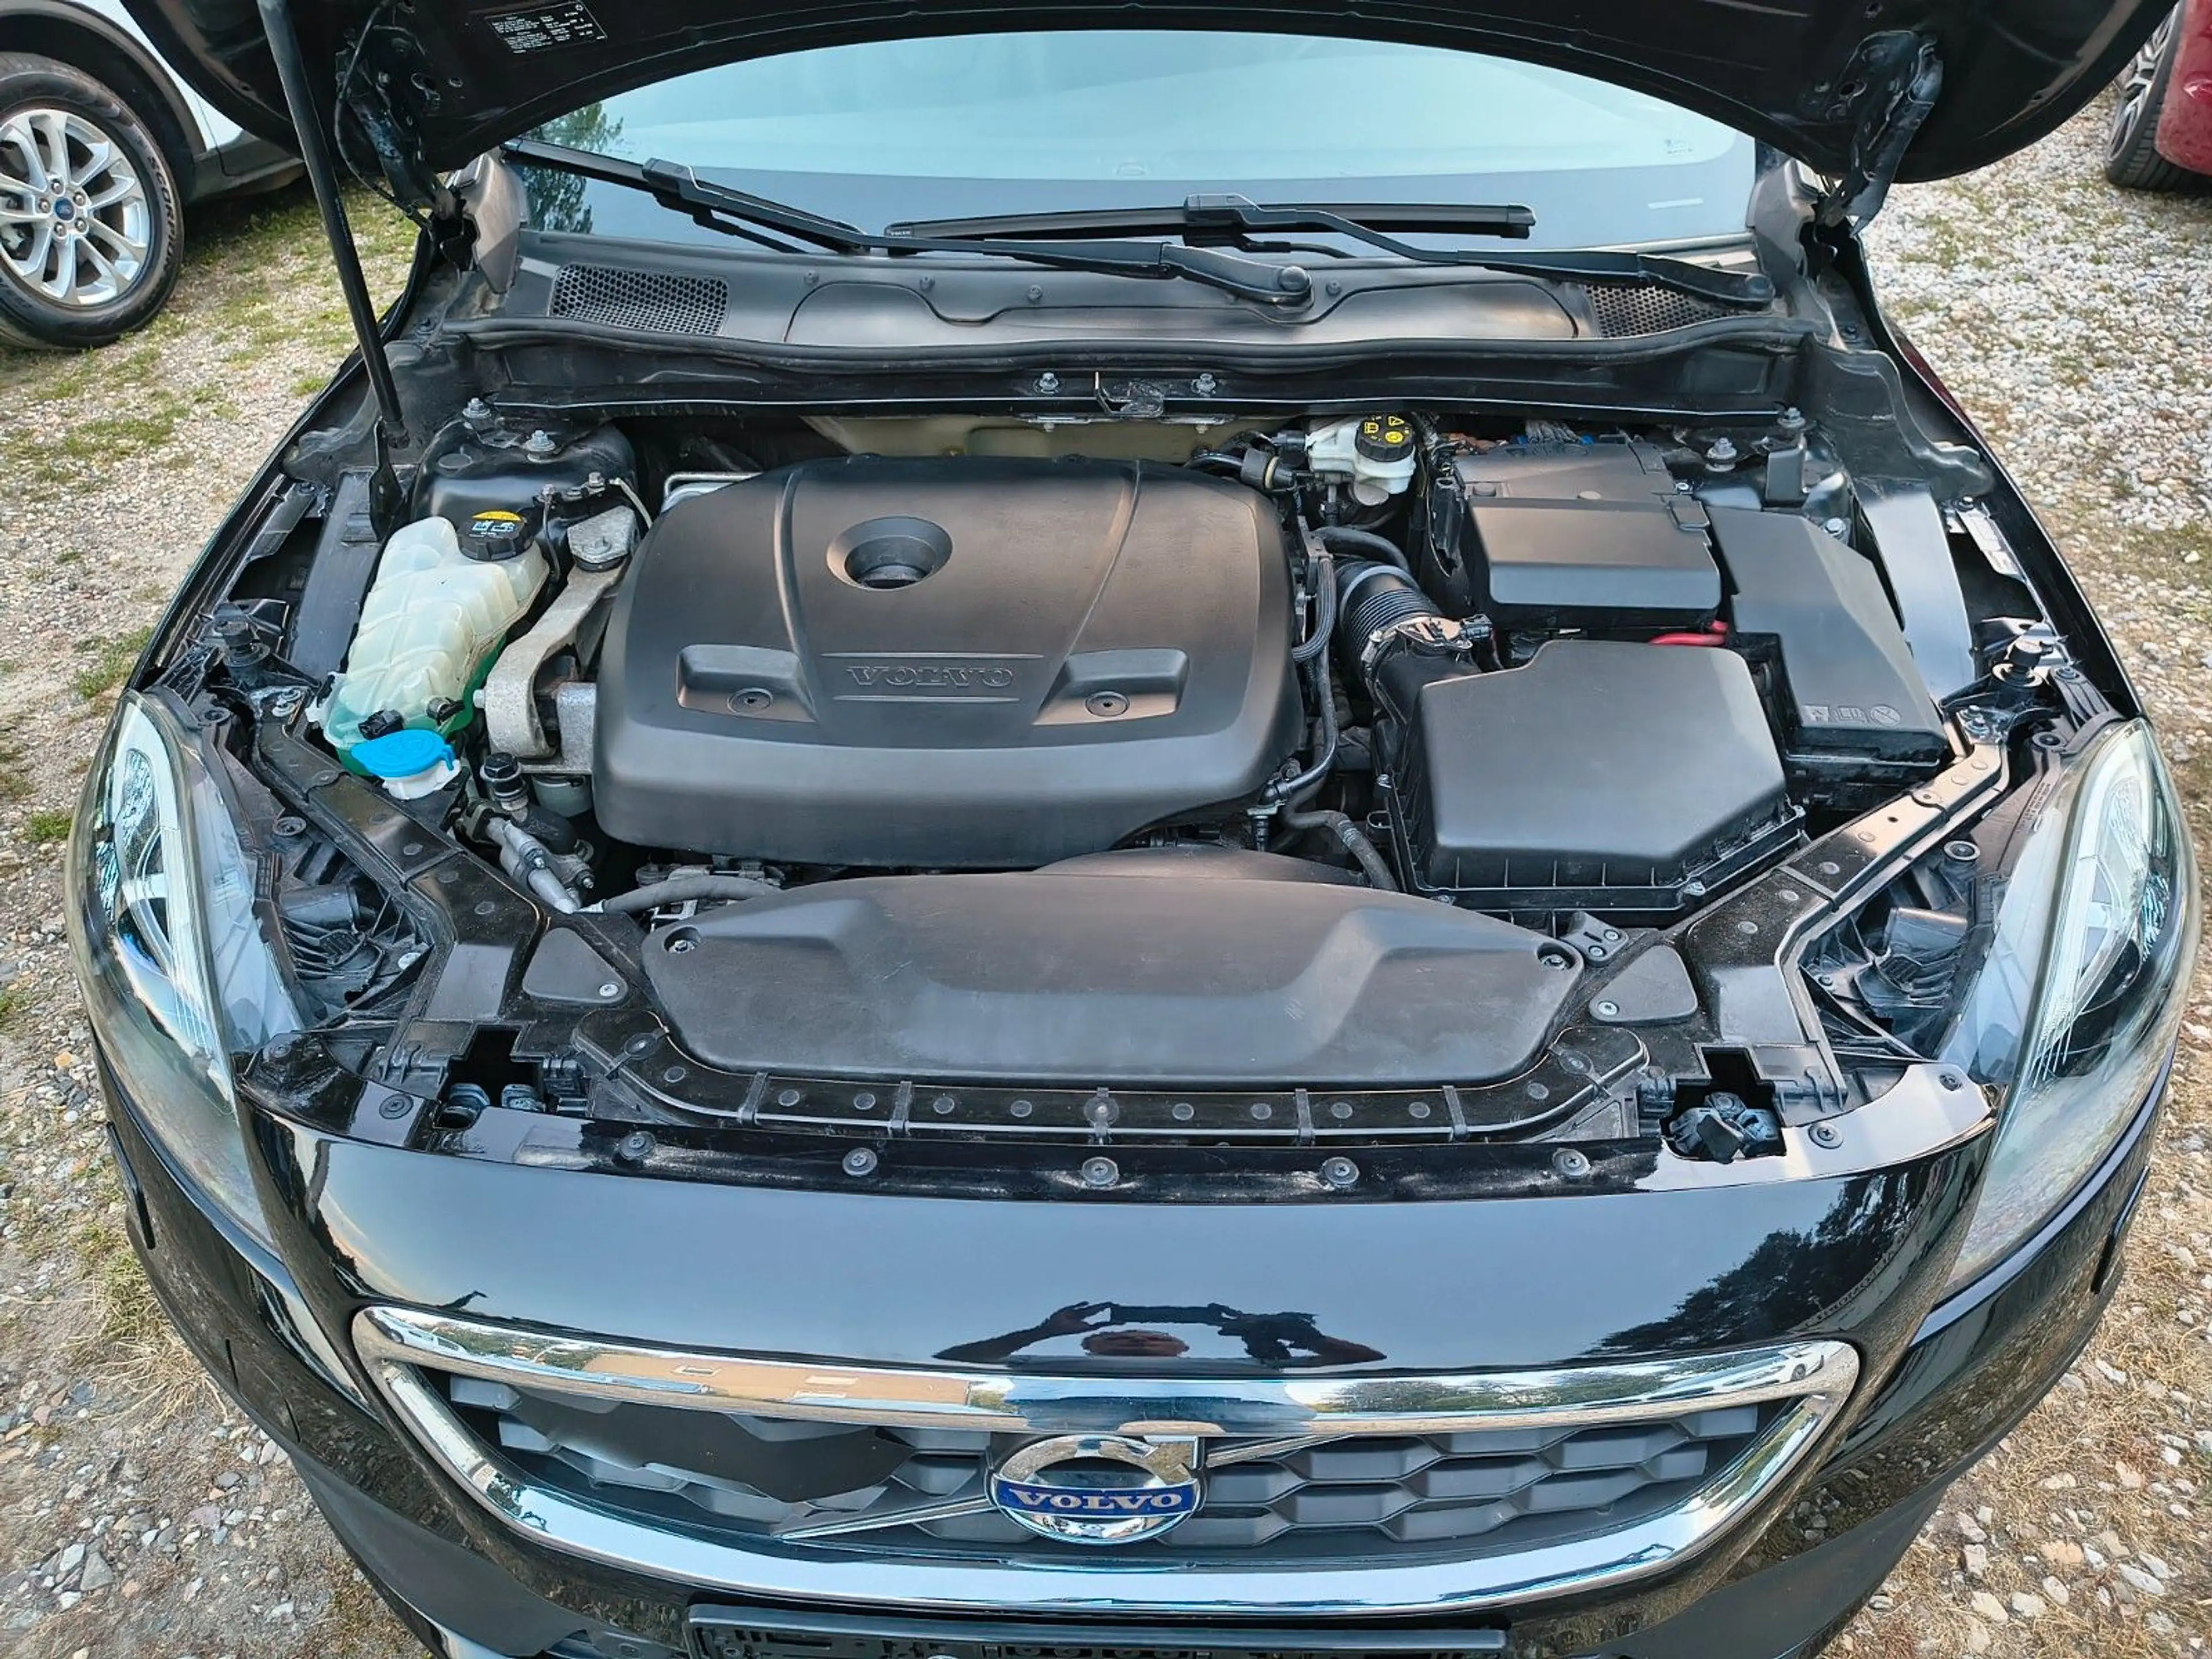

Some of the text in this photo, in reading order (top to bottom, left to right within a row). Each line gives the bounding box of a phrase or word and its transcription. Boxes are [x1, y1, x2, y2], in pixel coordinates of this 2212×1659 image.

[147, 155, 176, 271] SCORPION
[846, 665, 1015, 687] VOLVO
[1009, 1488, 1182, 1510] VOLVO
